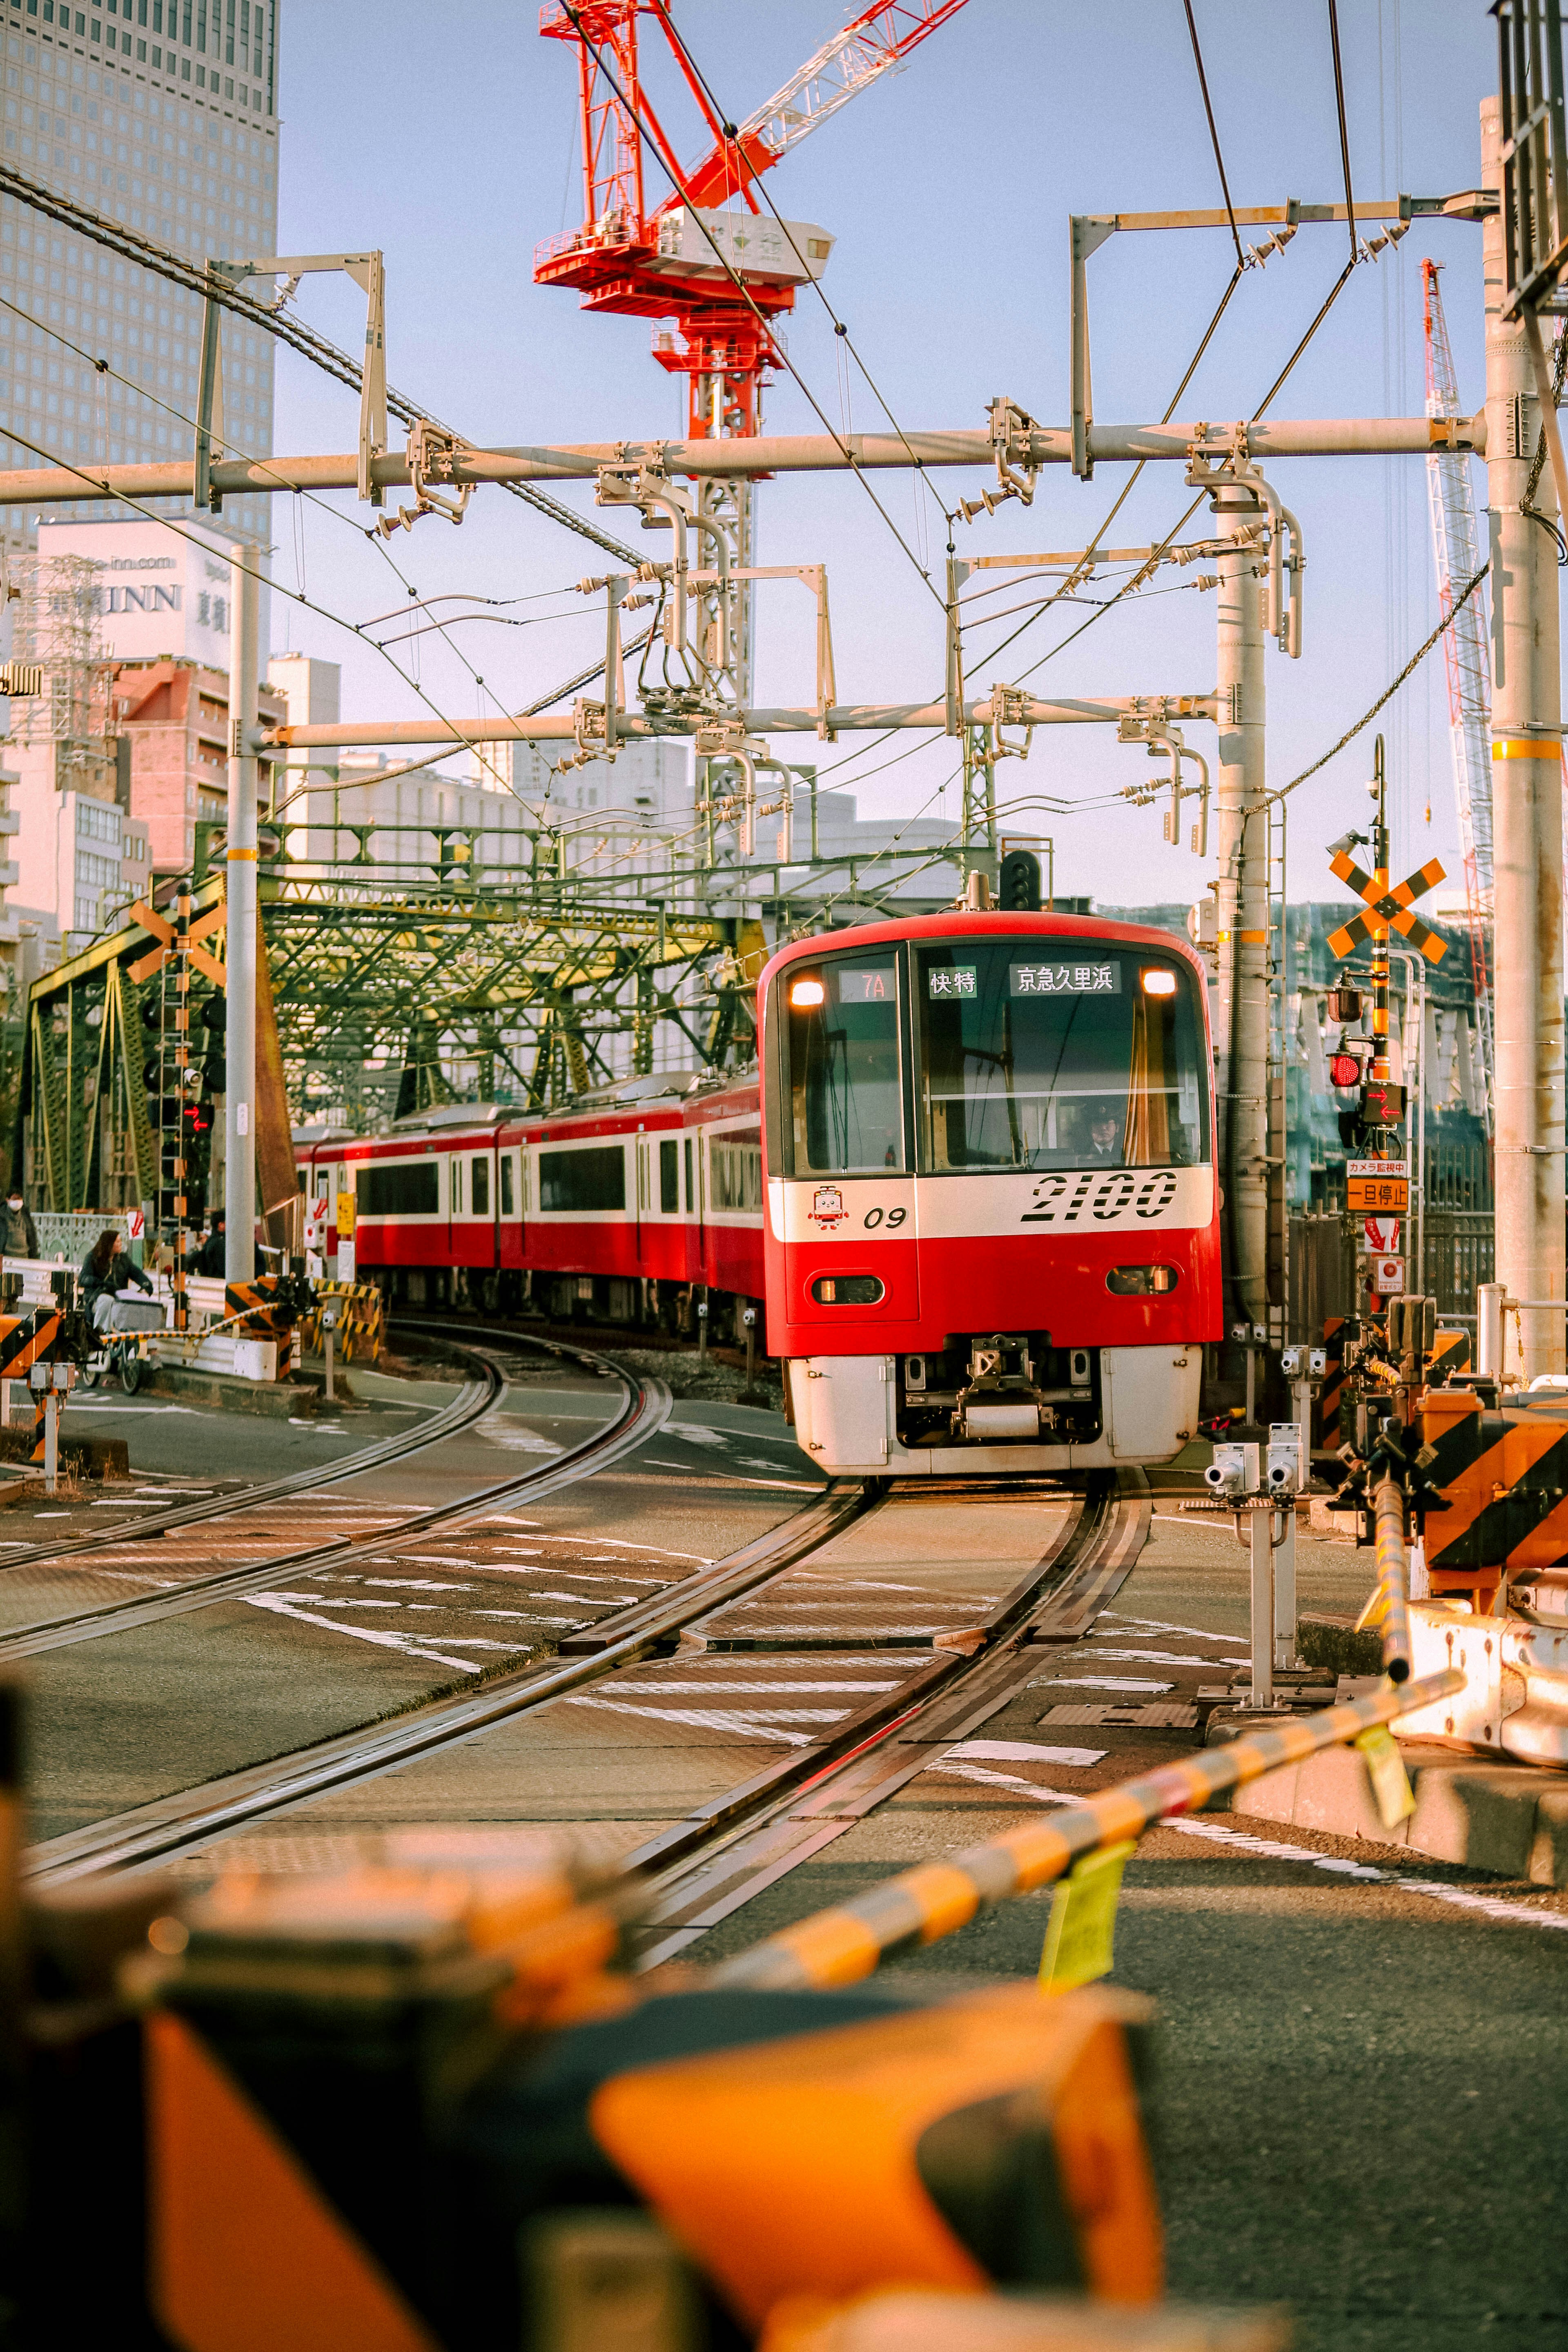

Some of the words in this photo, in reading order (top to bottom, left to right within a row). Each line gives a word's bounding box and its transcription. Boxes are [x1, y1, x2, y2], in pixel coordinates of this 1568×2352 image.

[862, 974, 884, 997] 7A
[931, 971, 976, 994] 快特
[1018, 966, 1114, 991] 京急久里浜
[1350, 1163, 1404, 1172] カメラ監視中
[1020, 1172, 1178, 1222] 2100
[1349, 1185, 1407, 1205] 一旦停止
[864, 1207, 907, 1229] 09
